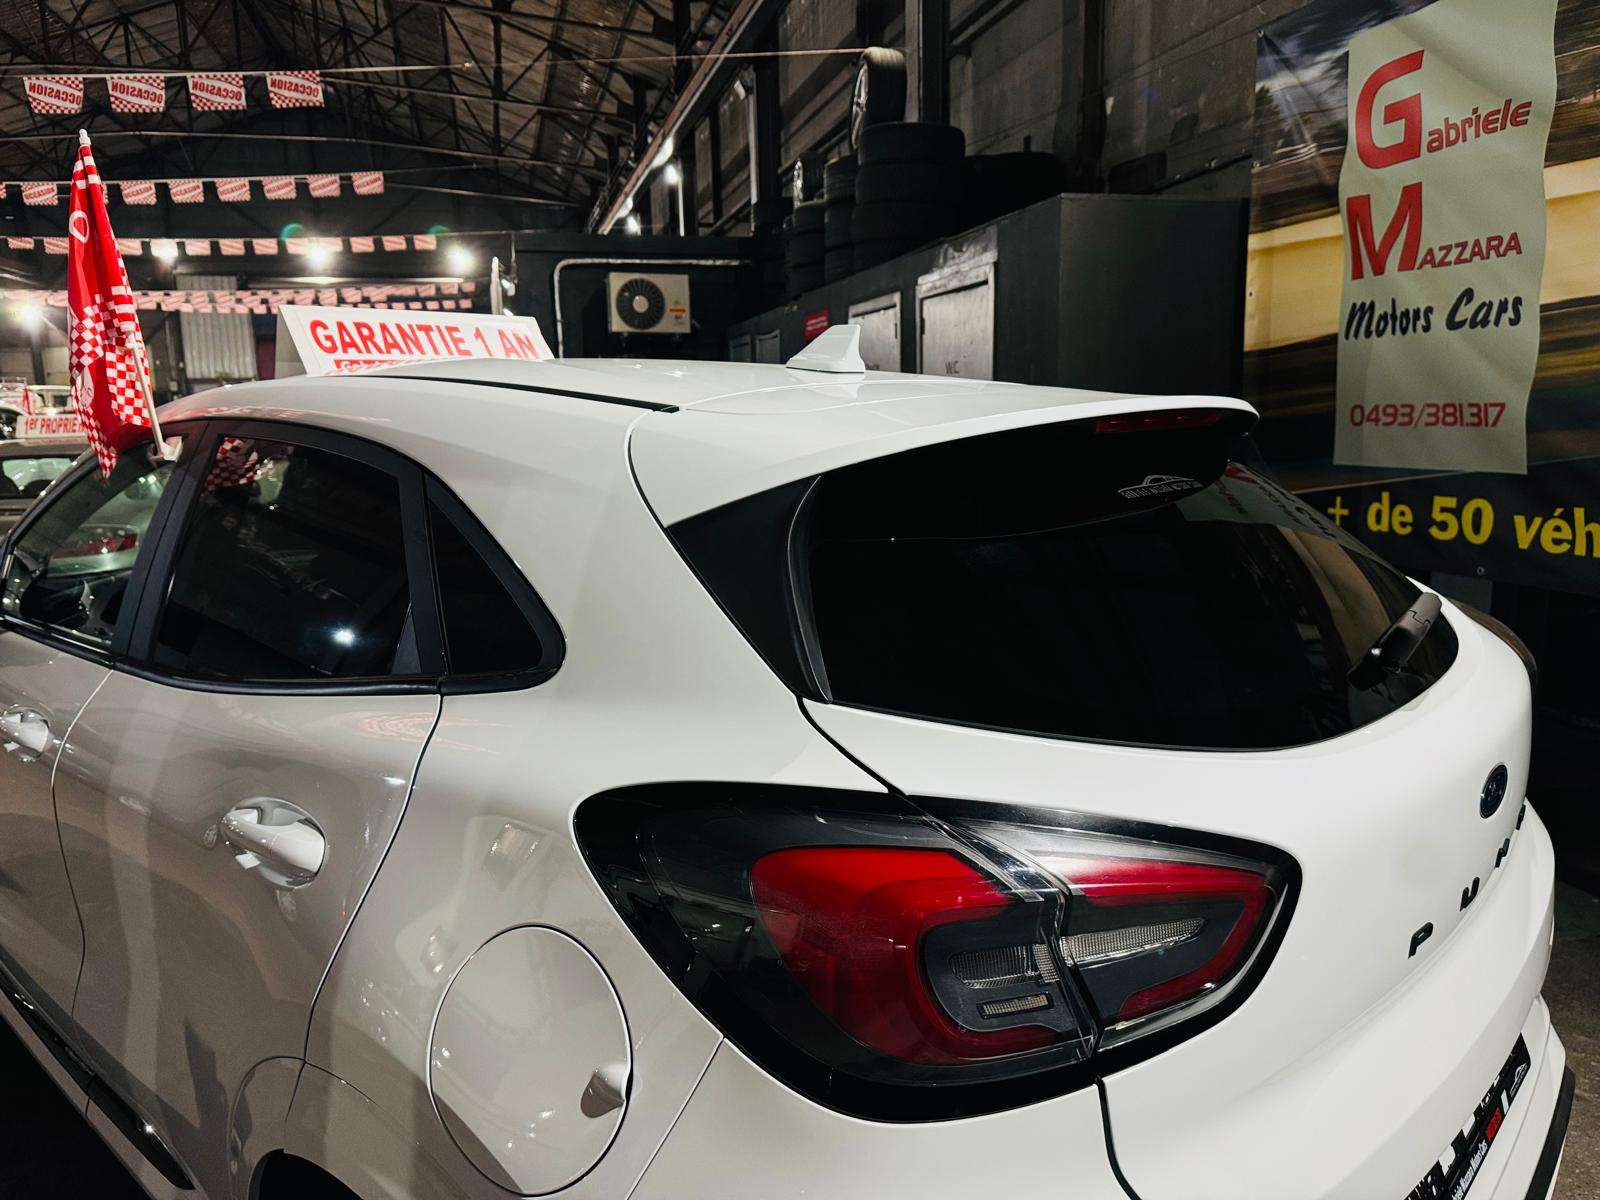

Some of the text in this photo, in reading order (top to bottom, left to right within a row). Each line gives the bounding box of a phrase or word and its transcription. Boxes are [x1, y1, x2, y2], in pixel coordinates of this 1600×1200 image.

[1344, 287, 1524, 341] Motors Cars
[309, 319, 541, 361] GARANTIE 1 AN
[40, 417, 86, 434] PROPRIE
[1366, 491, 1414, 536] de
[1428, 495, 1494, 546] 50
